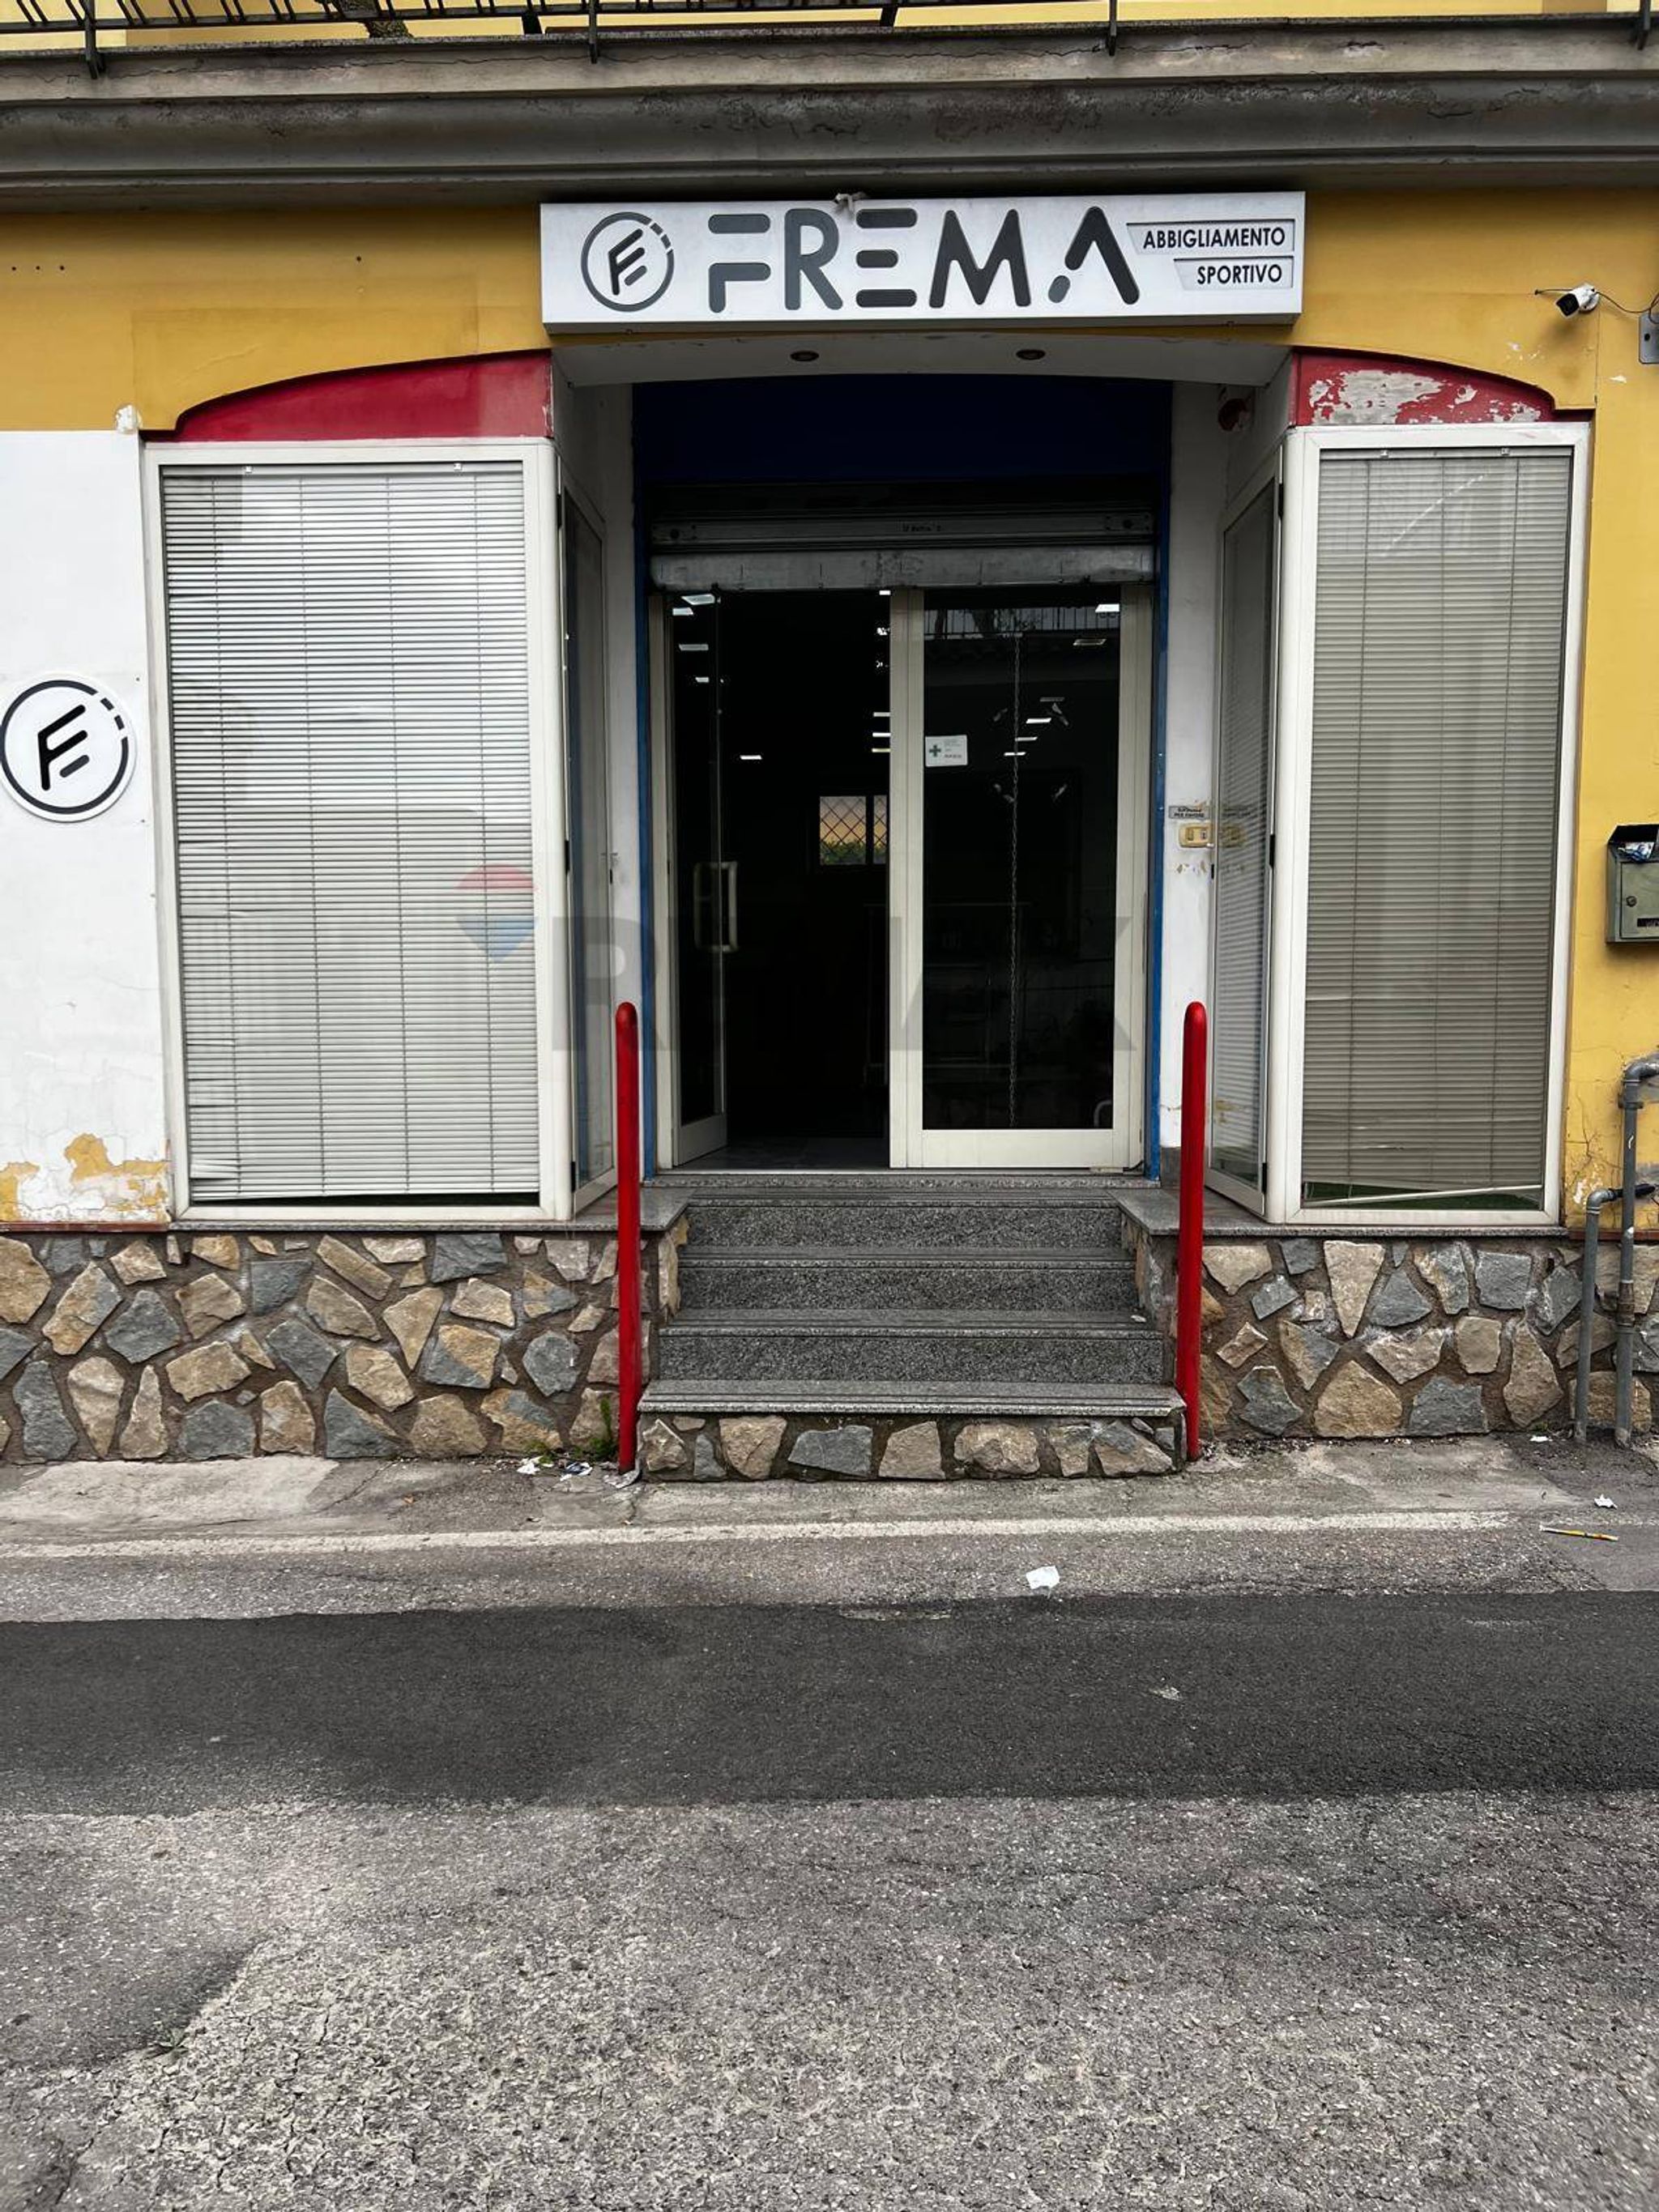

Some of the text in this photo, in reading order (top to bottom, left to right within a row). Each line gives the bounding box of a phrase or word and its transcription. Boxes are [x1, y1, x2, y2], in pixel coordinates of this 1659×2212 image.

[1143, 227, 1286, 249] ABBIGLIAMENTO
[707, 205, 1141, 313] FREMA
[1196, 263, 1283, 285] SPORTIVO
